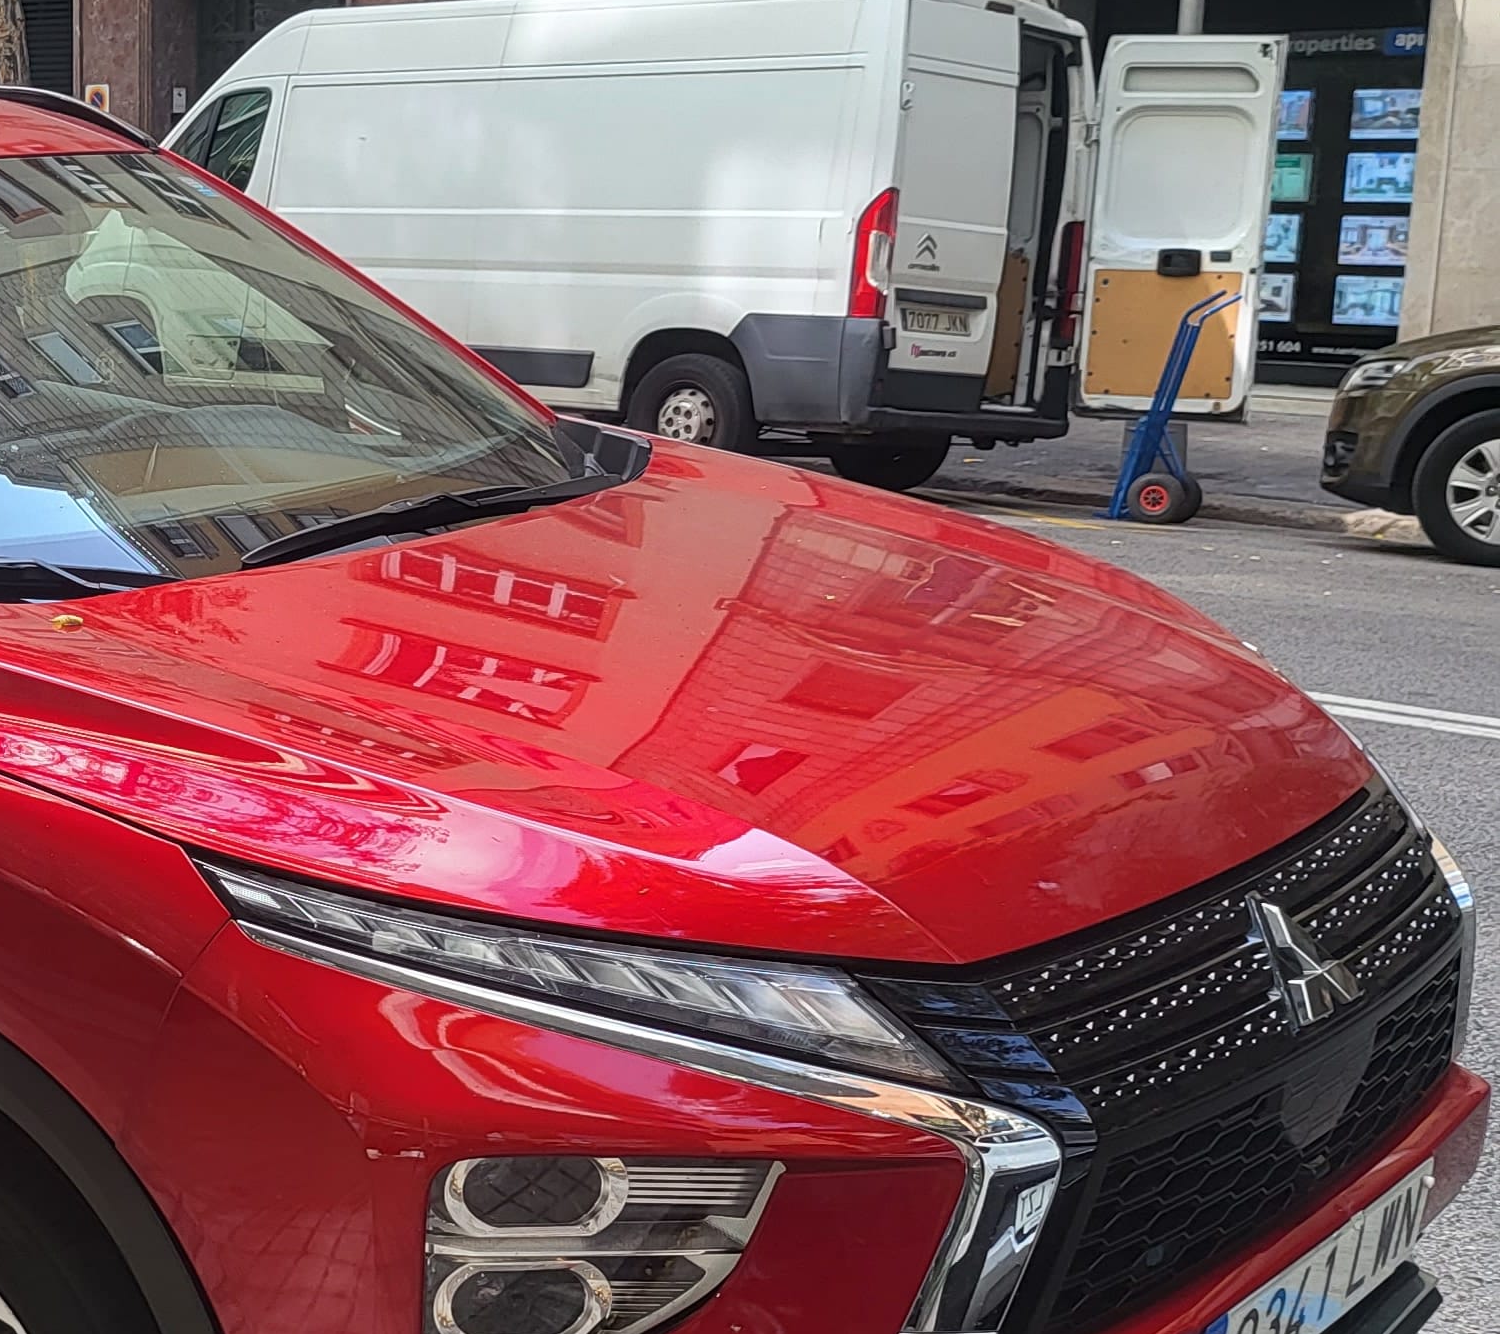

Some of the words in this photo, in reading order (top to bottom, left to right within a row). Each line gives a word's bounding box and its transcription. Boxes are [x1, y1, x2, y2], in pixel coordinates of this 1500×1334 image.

[1288, 35, 1376, 56] roperties
[908, 311, 940, 330] 7077
[1345, 1179, 1425, 1299] LWN
